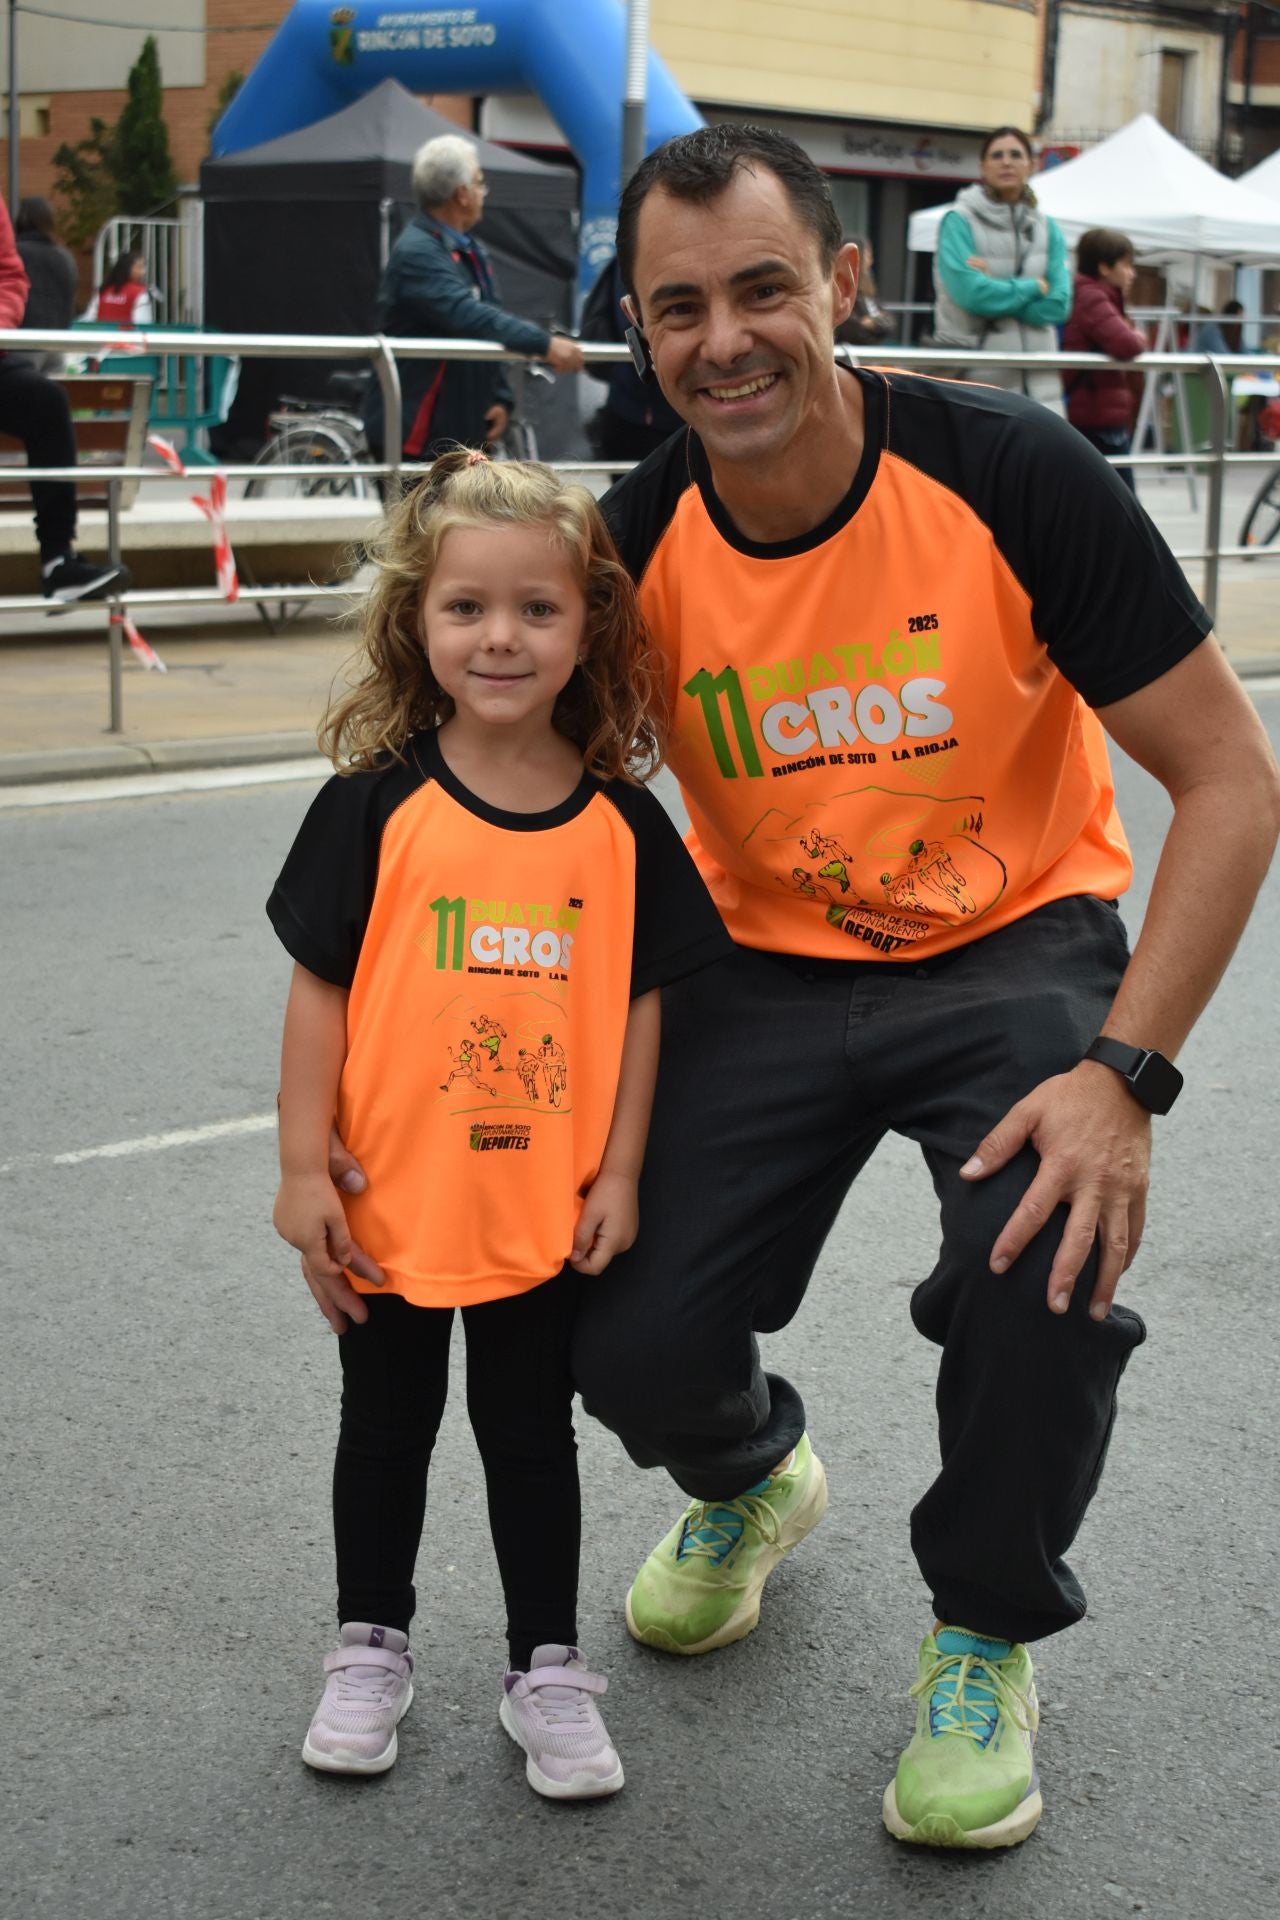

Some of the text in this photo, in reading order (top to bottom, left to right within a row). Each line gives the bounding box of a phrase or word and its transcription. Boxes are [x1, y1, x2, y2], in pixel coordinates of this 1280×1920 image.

[461, 9, 477, 24] DE
[422, 27, 446, 48] DE
[449, 23, 496, 48] SOTO
[907, 614, 939, 633] 2025
[747, 630, 942, 700] DUATLÓN
[683, 666, 764, 779] 11
[760, 677, 955, 756] CROS
[771, 738, 959, 777] RINCÓN DE SOTO LA RIOJA
[429, 895, 466, 971] 11
[844, 919, 917, 953] DEPORT
[849, 910, 926, 939] AYUNTAMIENTO
[889, 915, 901, 925] DE
[902, 919, 930, 931] SOTO
[469, 925, 574, 970] CROS
[504, 968, 514, 976] DE
[517, 969, 540, 978] SOTO
[549, 972, 559, 980] LA
[480, 1135, 531, 1151] DEPORTES
